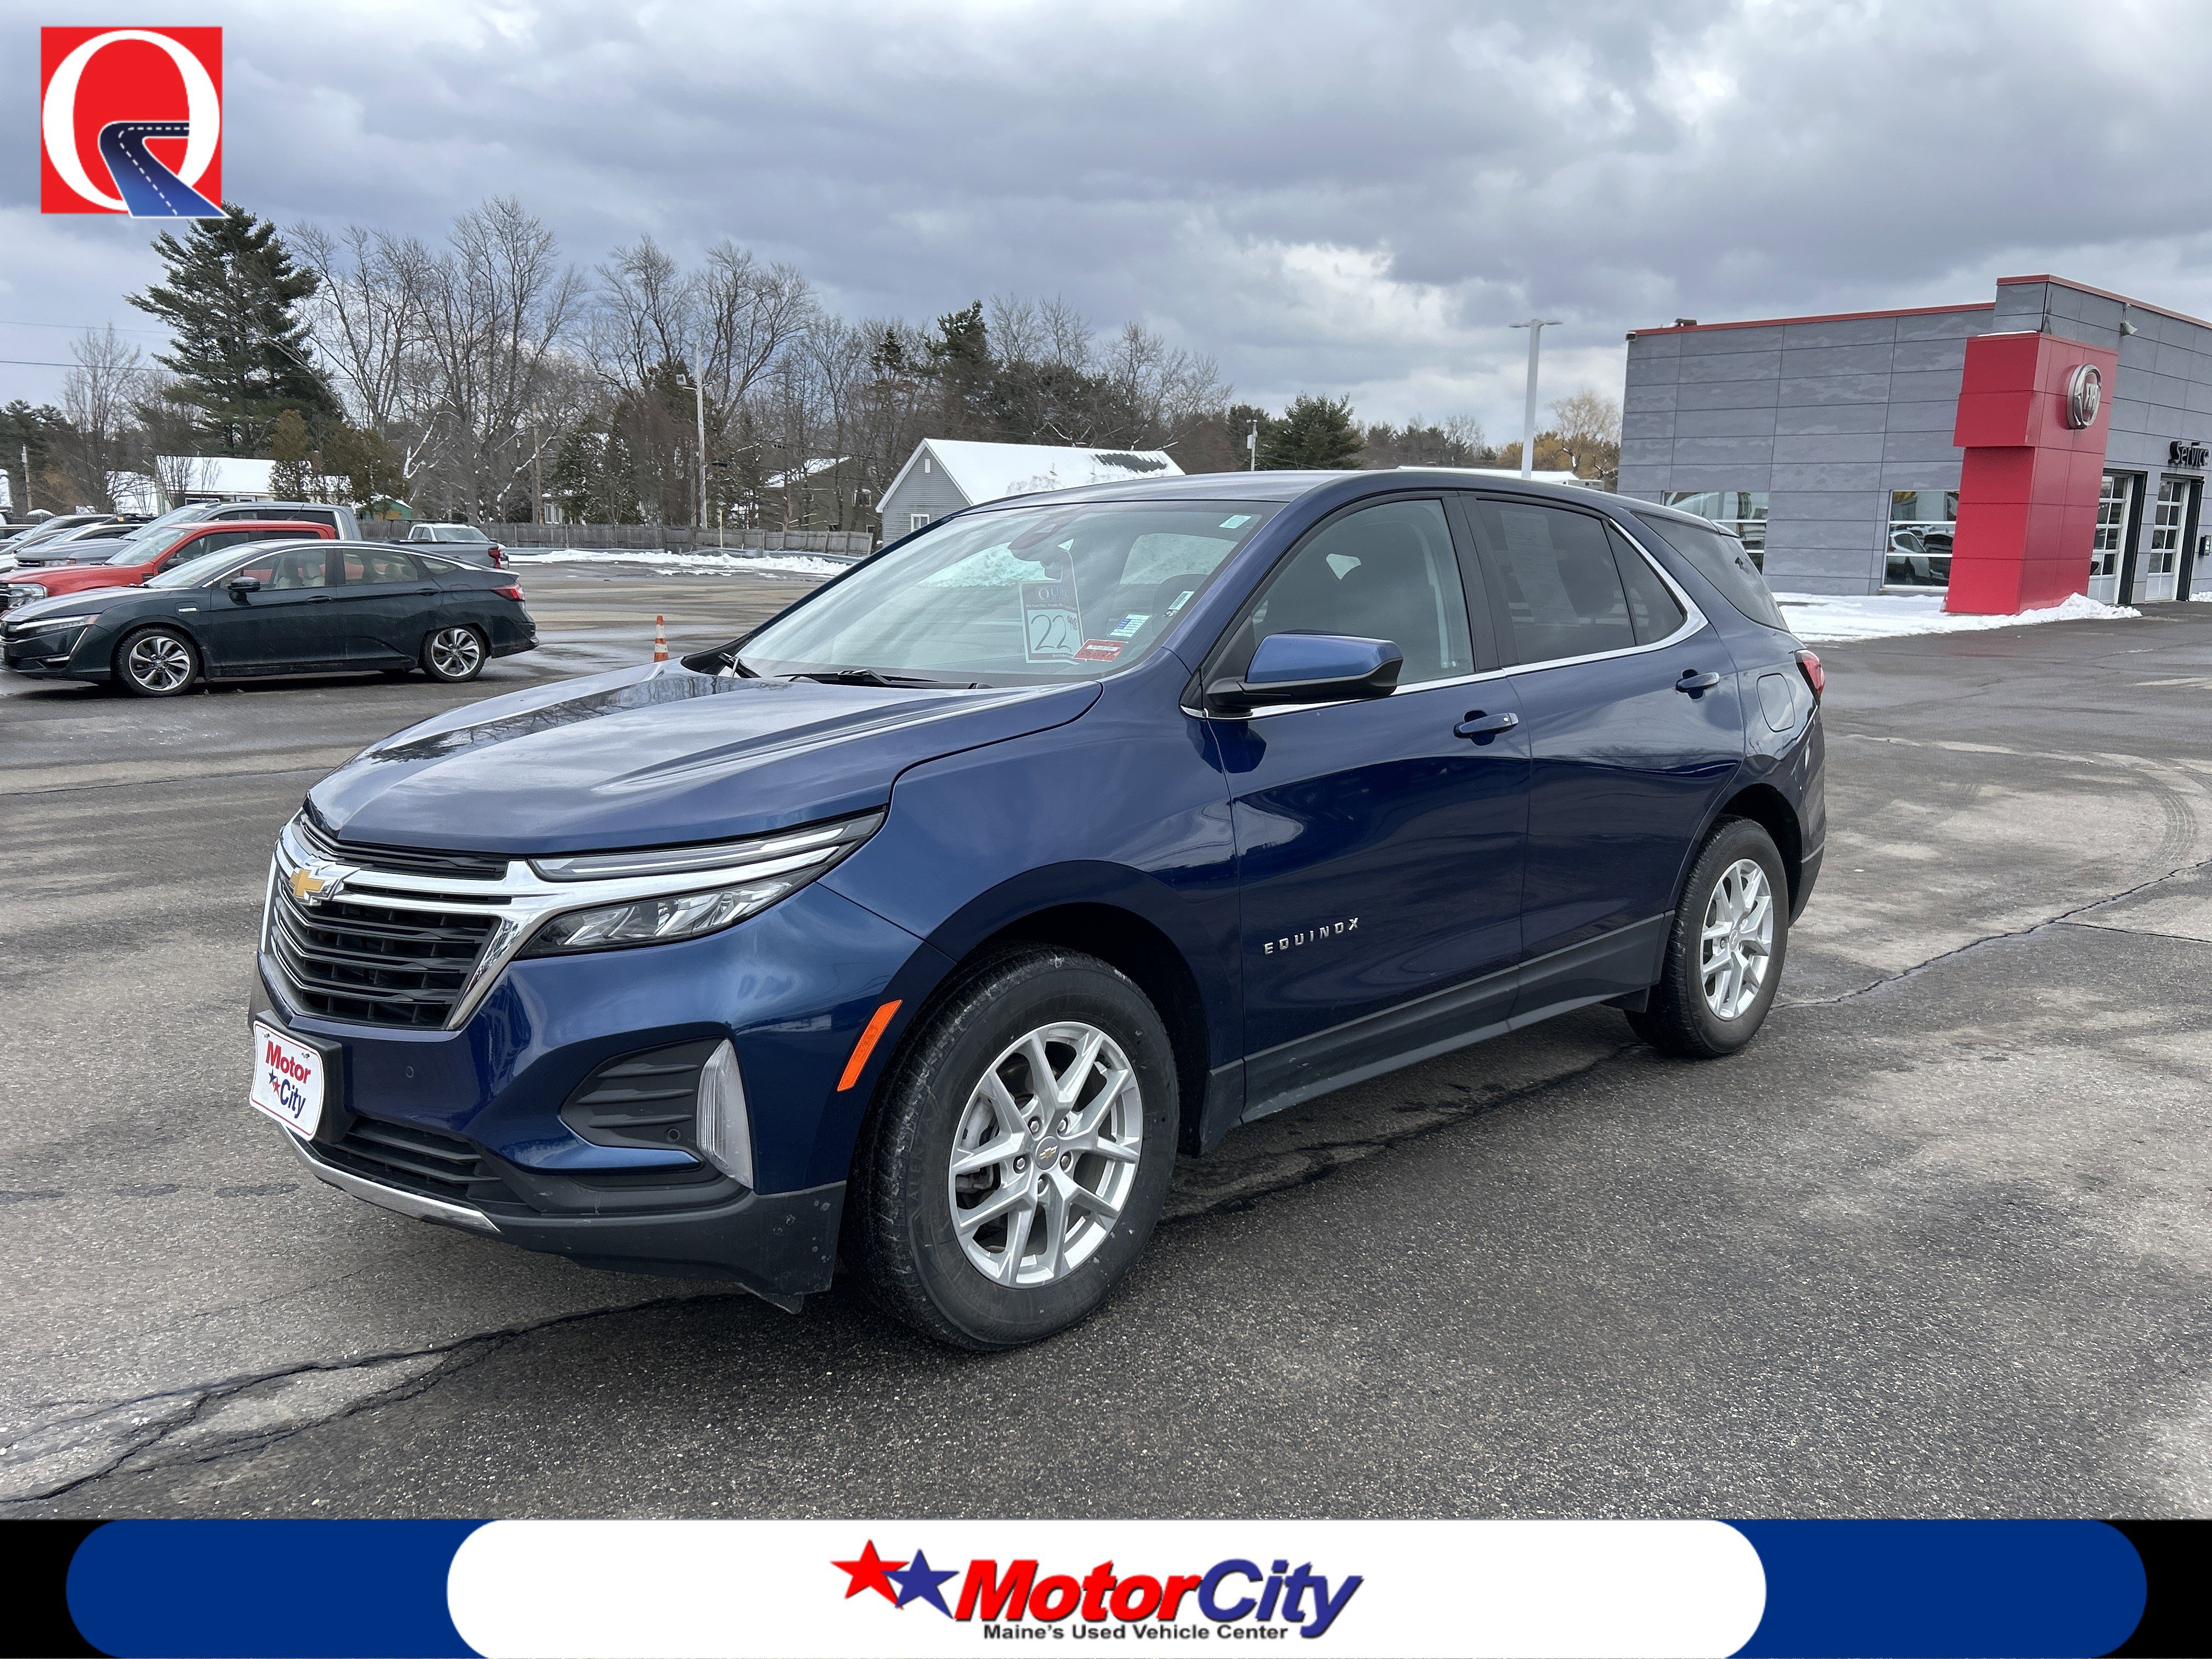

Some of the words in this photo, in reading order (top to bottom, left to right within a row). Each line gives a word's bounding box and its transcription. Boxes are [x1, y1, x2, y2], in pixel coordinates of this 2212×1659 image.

[2169, 440, 2209, 467] Service
[1263, 917, 1359, 955] EQUINOX
[265, 1040, 312, 1084] Motor
[279, 1079, 307, 1119] City
